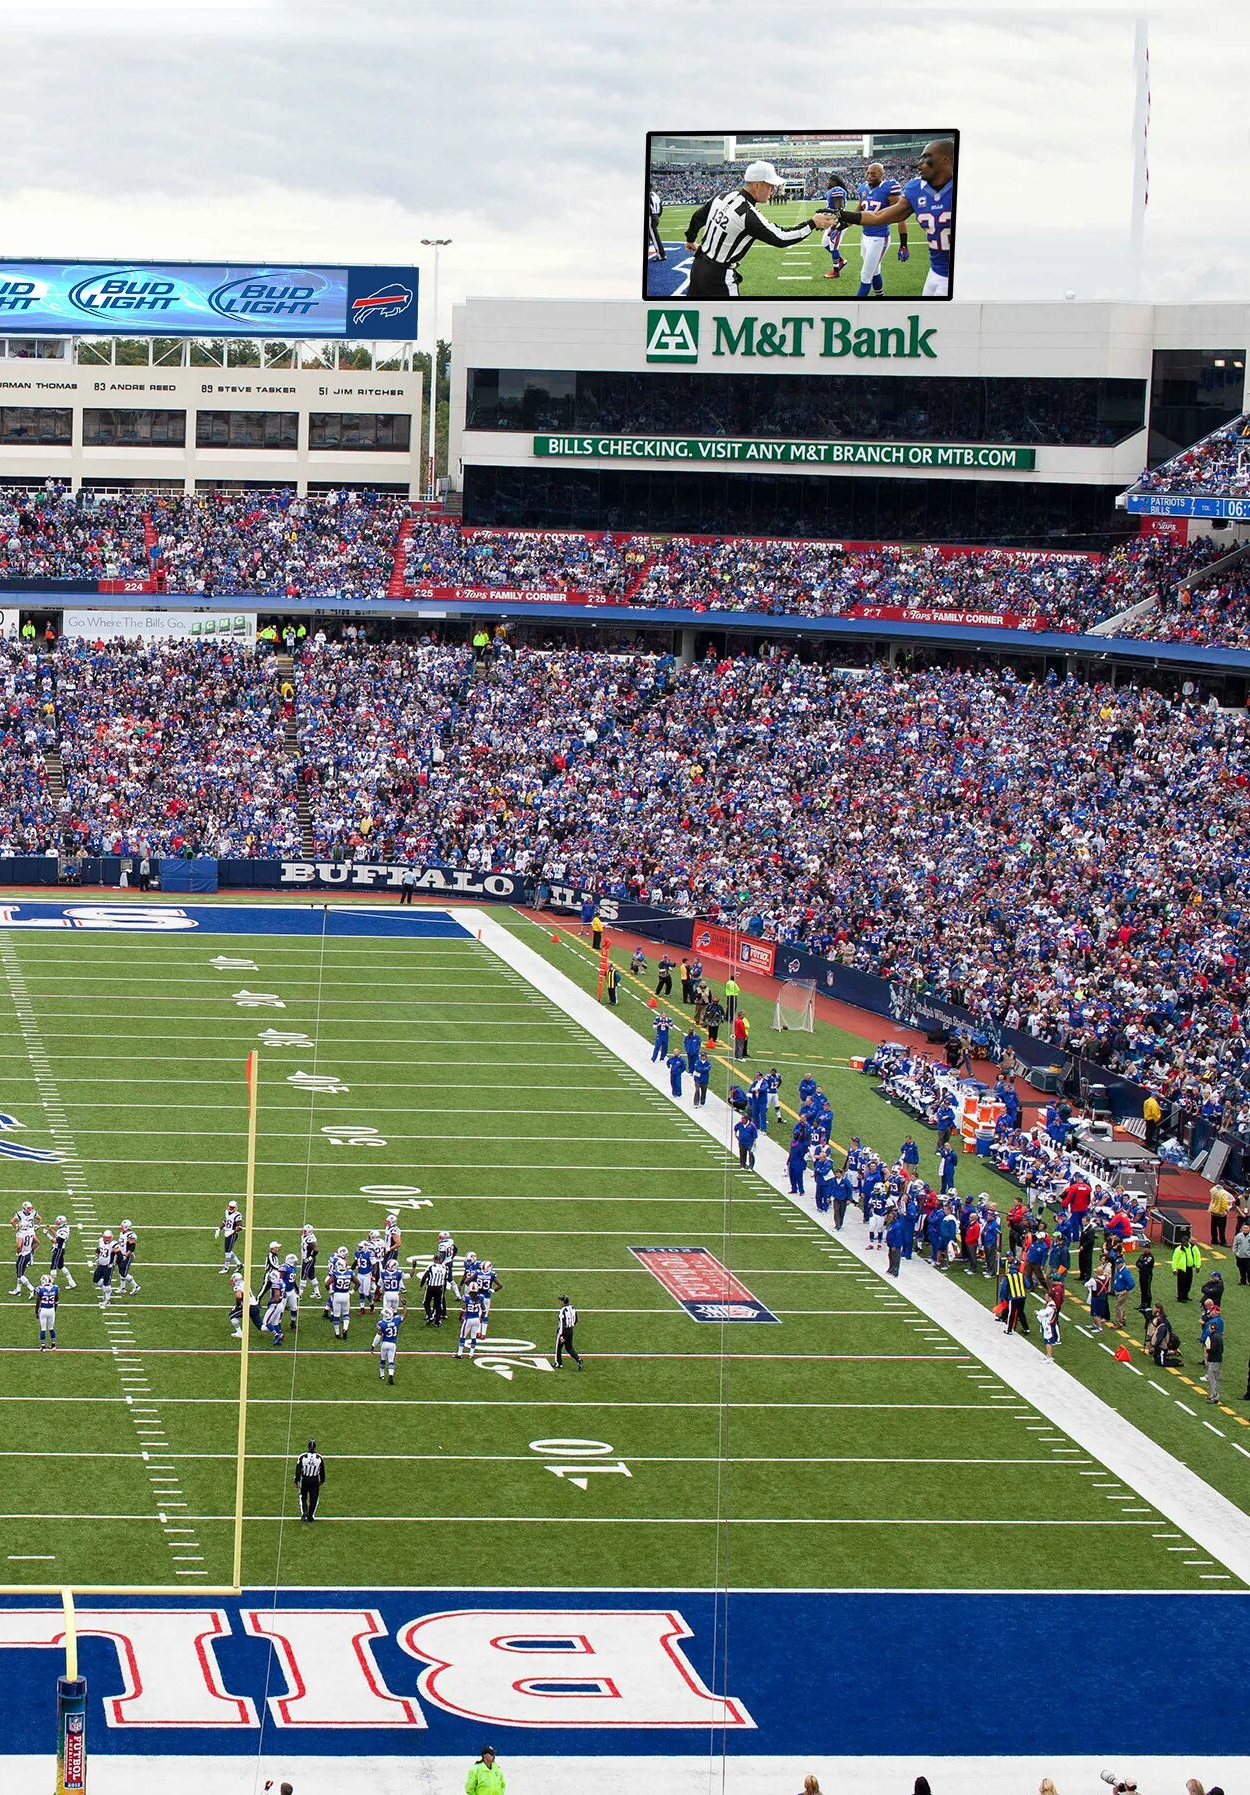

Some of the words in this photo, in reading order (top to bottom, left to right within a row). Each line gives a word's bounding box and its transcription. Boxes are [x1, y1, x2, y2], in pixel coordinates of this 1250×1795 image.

[711, 208, 729, 230] 132
[100, 279, 176, 294] BUD
[239, 284, 314, 300] BUD
[85, 295, 180, 310] LIGHT
[224, 298, 319, 315] LIGHT
[712, 315, 815, 357] M&T
[820, 314, 938, 358] Bank
[35, 382, 78, 390] THOMAS
[93, 382, 107, 391] 83
[201, 385, 214, 393] 89
[255, 386, 297, 394] TASKER
[318, 386, 328, 395] 51
[357, 388, 405, 396] RITCHER
[549, 439, 593, 454] BILLS
[598, 440, 693, 458] CHECKING.
[698, 442, 743, 458] VISIT
[746, 443, 785, 460] ANY
[790, 445, 828, 461] M&T
[833, 446, 904, 463] BRANCH
[908, 448, 932, 464] OR
[937, 449, 1016, 466] MTB.COM
[1150, 497, 1186, 507] PATRIOTS
[1191, 498, 1196, 506] 7
[1150, 506, 1170, 515] BILLS
[1191, 507, 1195, 516] 7
[921, 547, 940, 556] 27
[124, 582, 144, 592] 224
[490, 590, 530, 602] FAMILY
[531, 592, 567, 602] CORNER
[68, 617, 85, 628] Go
[87, 617, 121, 628] Where
[124, 617, 142, 628] The
[145, 617, 165, 629] Bills
[192, 614, 246, 632] ECMC
[933, 611, 966, 623] FAMILY
[966, 613, 1004, 625] CORNER
[1020, 617, 1037, 628] 227
[280, 863, 515, 896] BUFFALO
[320, 1125, 388, 1147] 50
[359, 1184, 434, 1210] 40
[335, 1278, 350, 1289] 92
[383, 1279, 398, 1289] 50
[477, 1279, 490, 1290] 93
[385, 1326, 397, 1338] 31
[465, 1337, 555, 1372] 20
[528, 1438, 633, 1478] 10
[72, 1735, 82, 1780] FUTBOL
